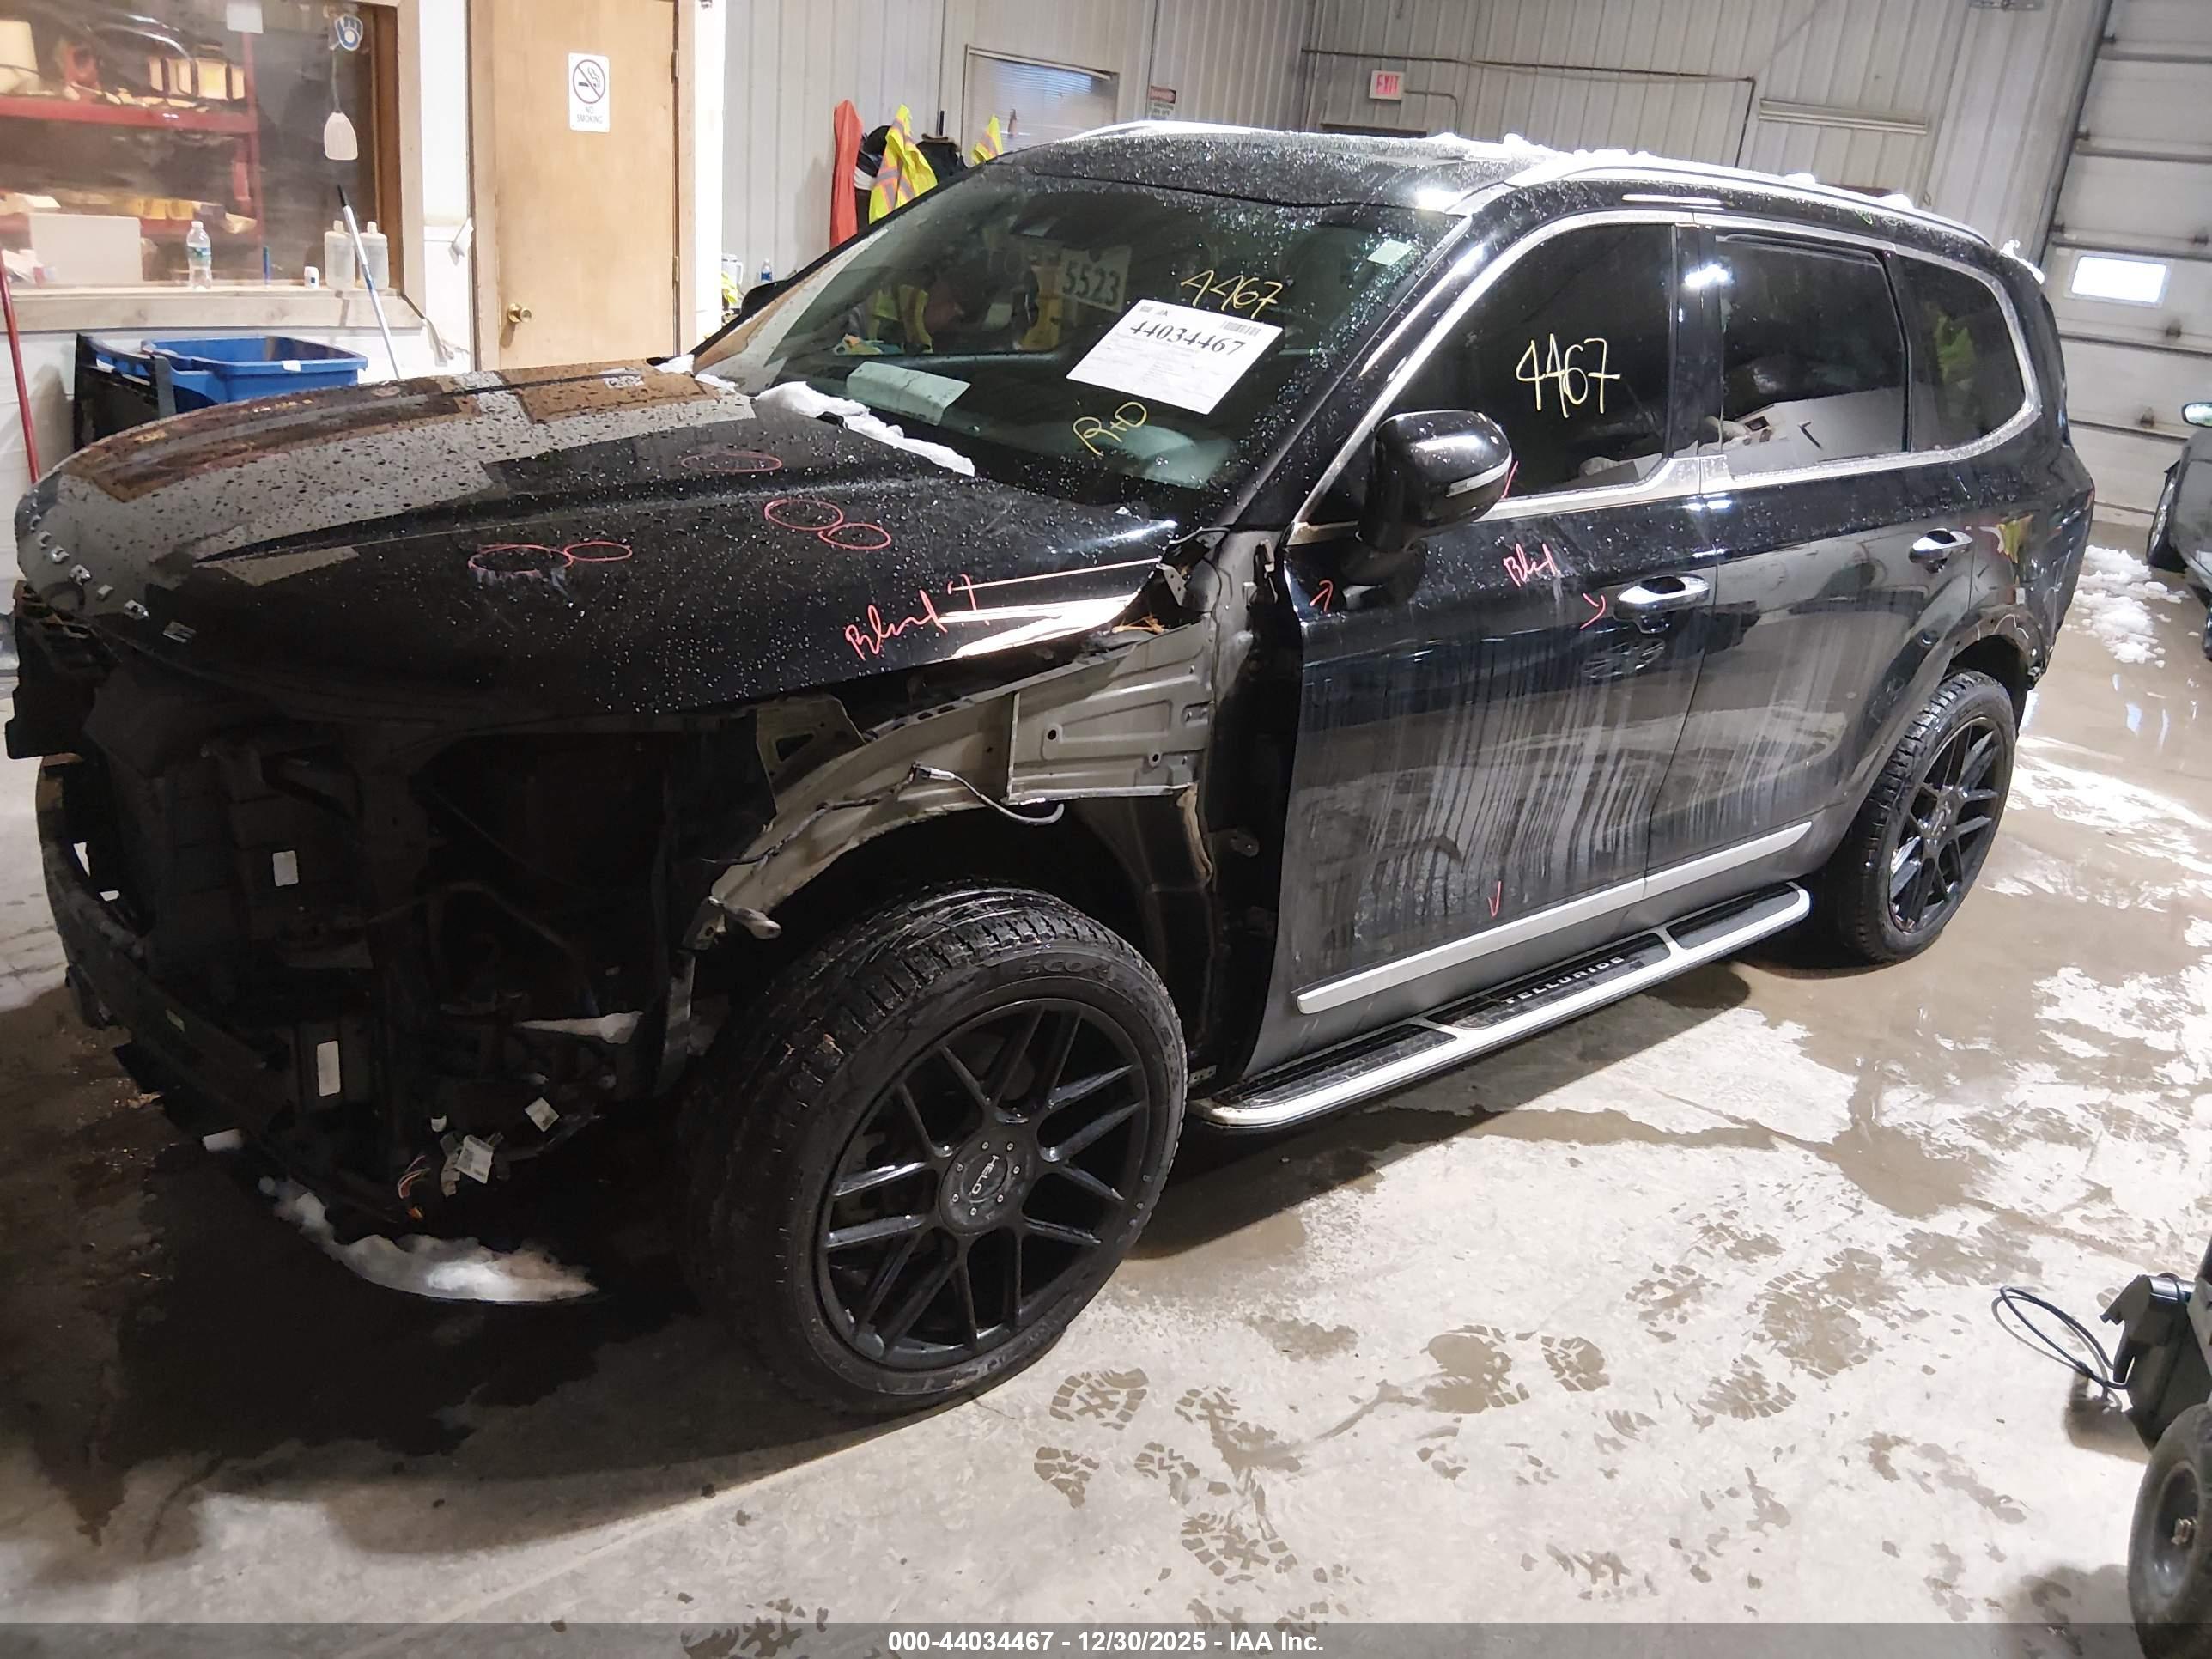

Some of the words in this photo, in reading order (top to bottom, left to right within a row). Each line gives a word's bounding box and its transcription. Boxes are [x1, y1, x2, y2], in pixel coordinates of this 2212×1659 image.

[1376, 75, 1400, 94] EXIT
[1180, 270, 1283, 320] 4467
[1130, 320, 1248, 356] 44034467
[1516, 333, 1621, 419] 4467
[1501, 956, 1625, 1005] TELLURIDE
[971, 1154, 1000, 1194] HELO
